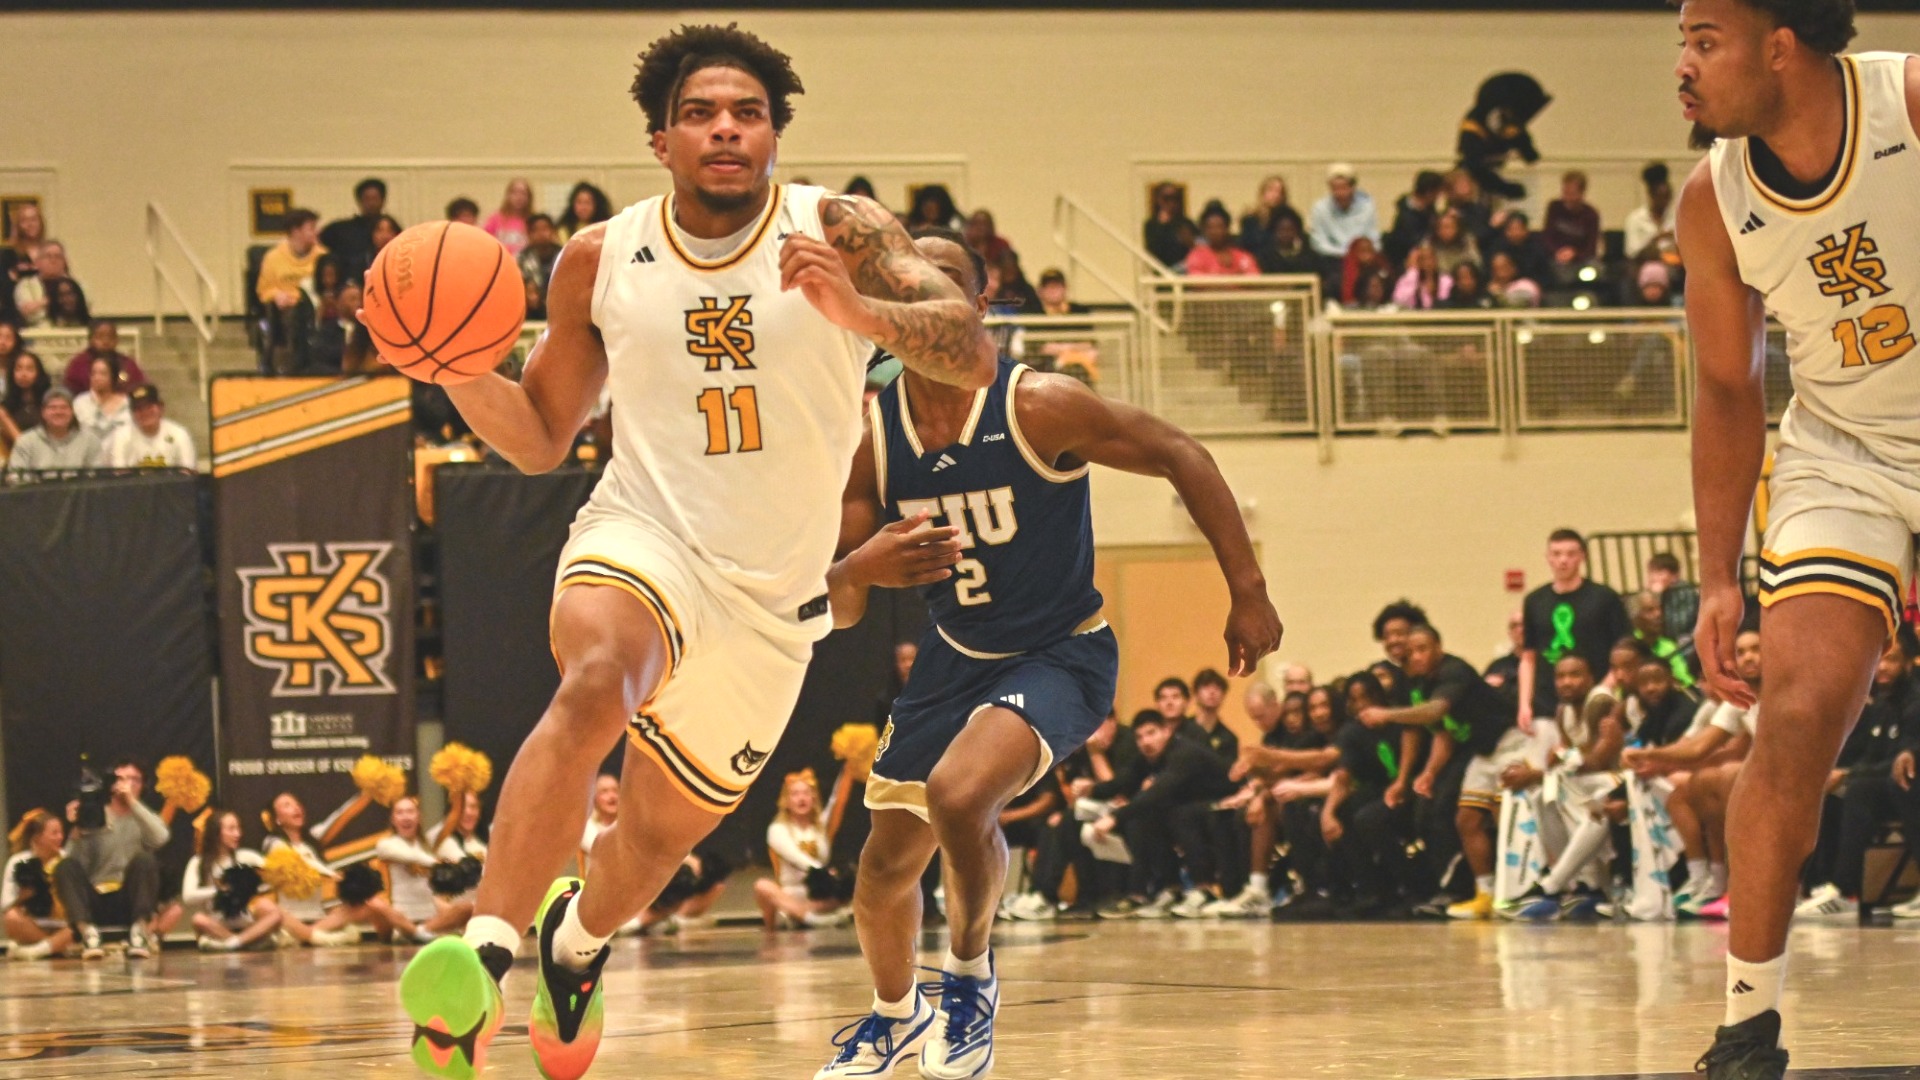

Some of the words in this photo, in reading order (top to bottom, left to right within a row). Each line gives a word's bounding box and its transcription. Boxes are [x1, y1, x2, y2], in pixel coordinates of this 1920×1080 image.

[1831, 304, 1917, 368] 12
[696, 385, 762, 456] 11
[955, 558, 992, 606] 2
[228, 760, 264, 775] PROUD
[266, 759, 315, 774] SPONSOR
[317, 758, 331, 773] OF
